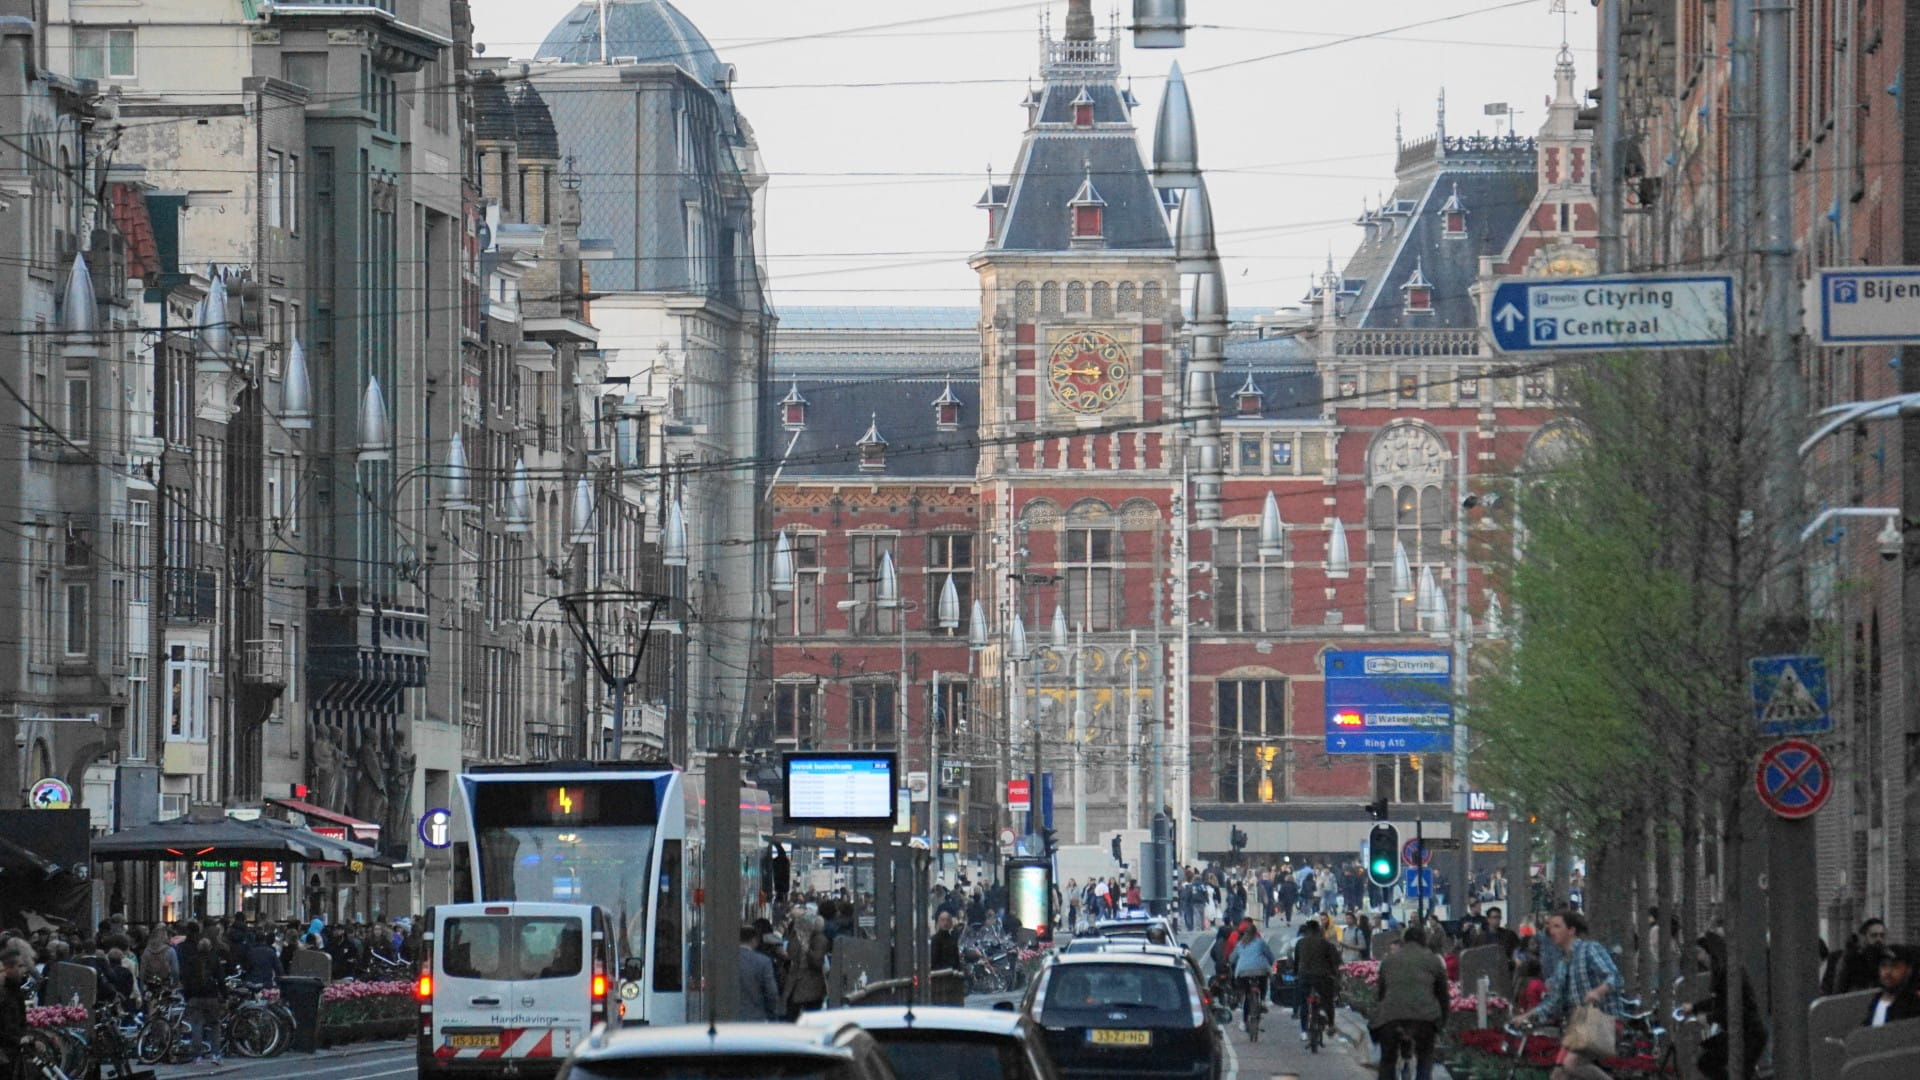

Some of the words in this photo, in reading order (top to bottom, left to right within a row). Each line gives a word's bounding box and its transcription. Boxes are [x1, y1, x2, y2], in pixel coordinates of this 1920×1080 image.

[1584, 287, 1673, 309] Cityring
[1863, 280, 1920, 303] Bijen
[1563, 316, 1659, 336] Centraal
[1398, 660, 1435, 670] Cityring
[1365, 739, 1386, 749] Ring
[1388, 738, 1406, 747] A10
[559, 787, 572, 814] 4
[491, 1015, 553, 1025] Handhaving
[1096, 1030, 1145, 1042] 33-ZJ-HD
